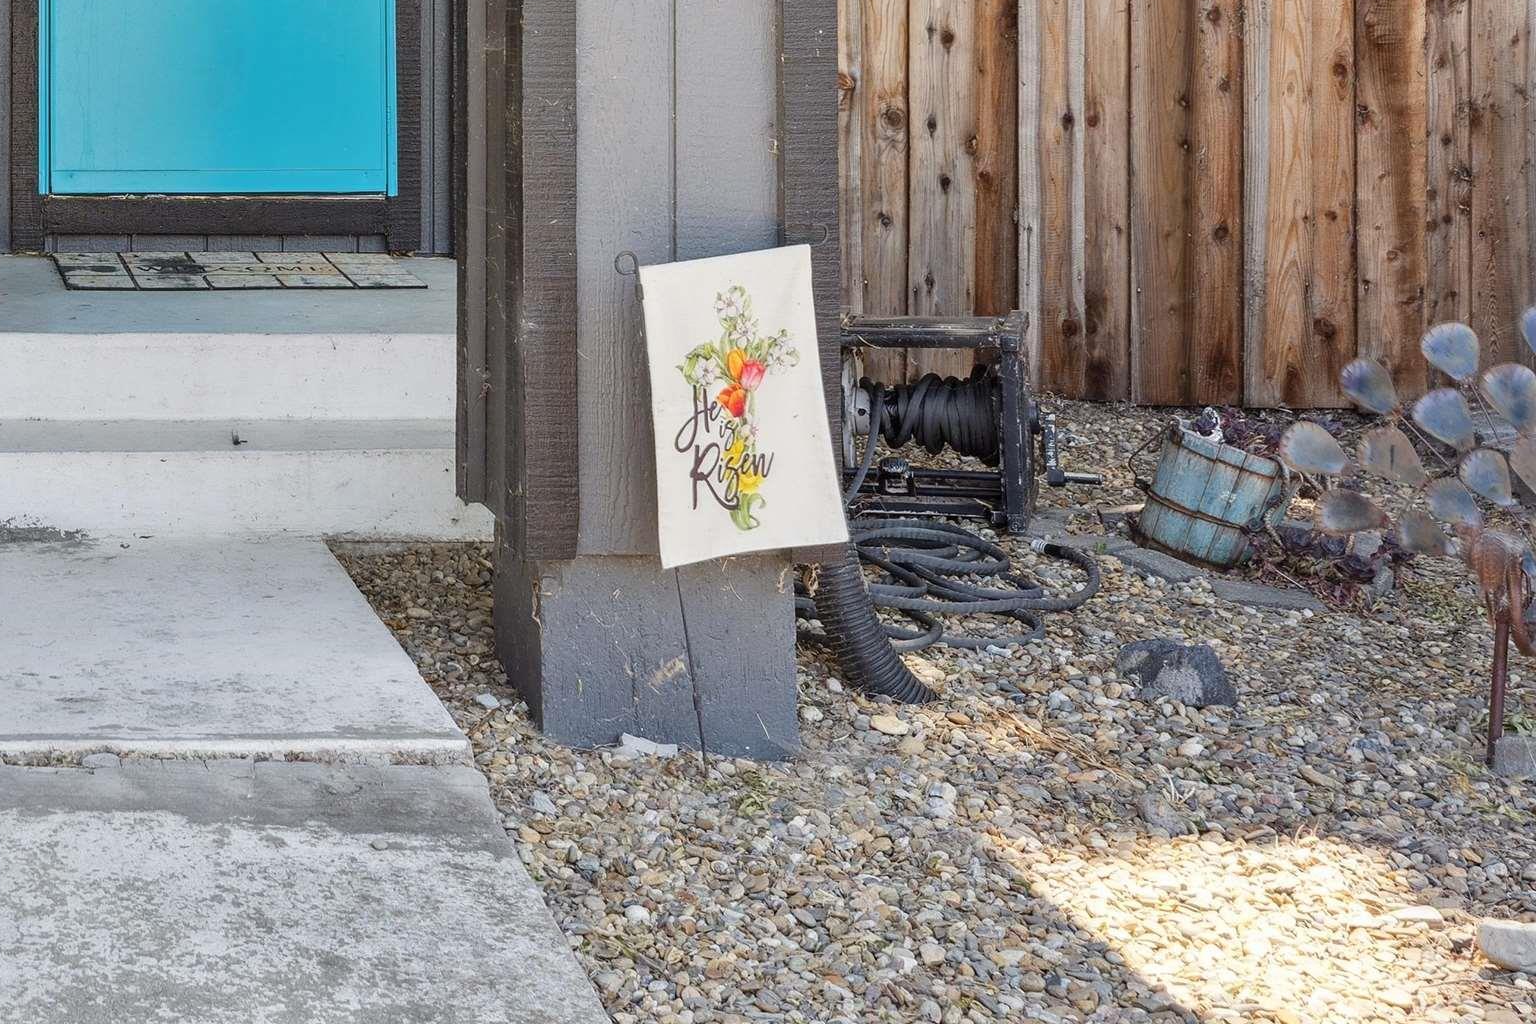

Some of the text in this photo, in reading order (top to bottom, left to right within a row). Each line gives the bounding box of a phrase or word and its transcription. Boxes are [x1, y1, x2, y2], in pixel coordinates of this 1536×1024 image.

[675, 385, 722, 453] He
[719, 418, 736, 450] is
[690, 442, 774, 510] Risen
